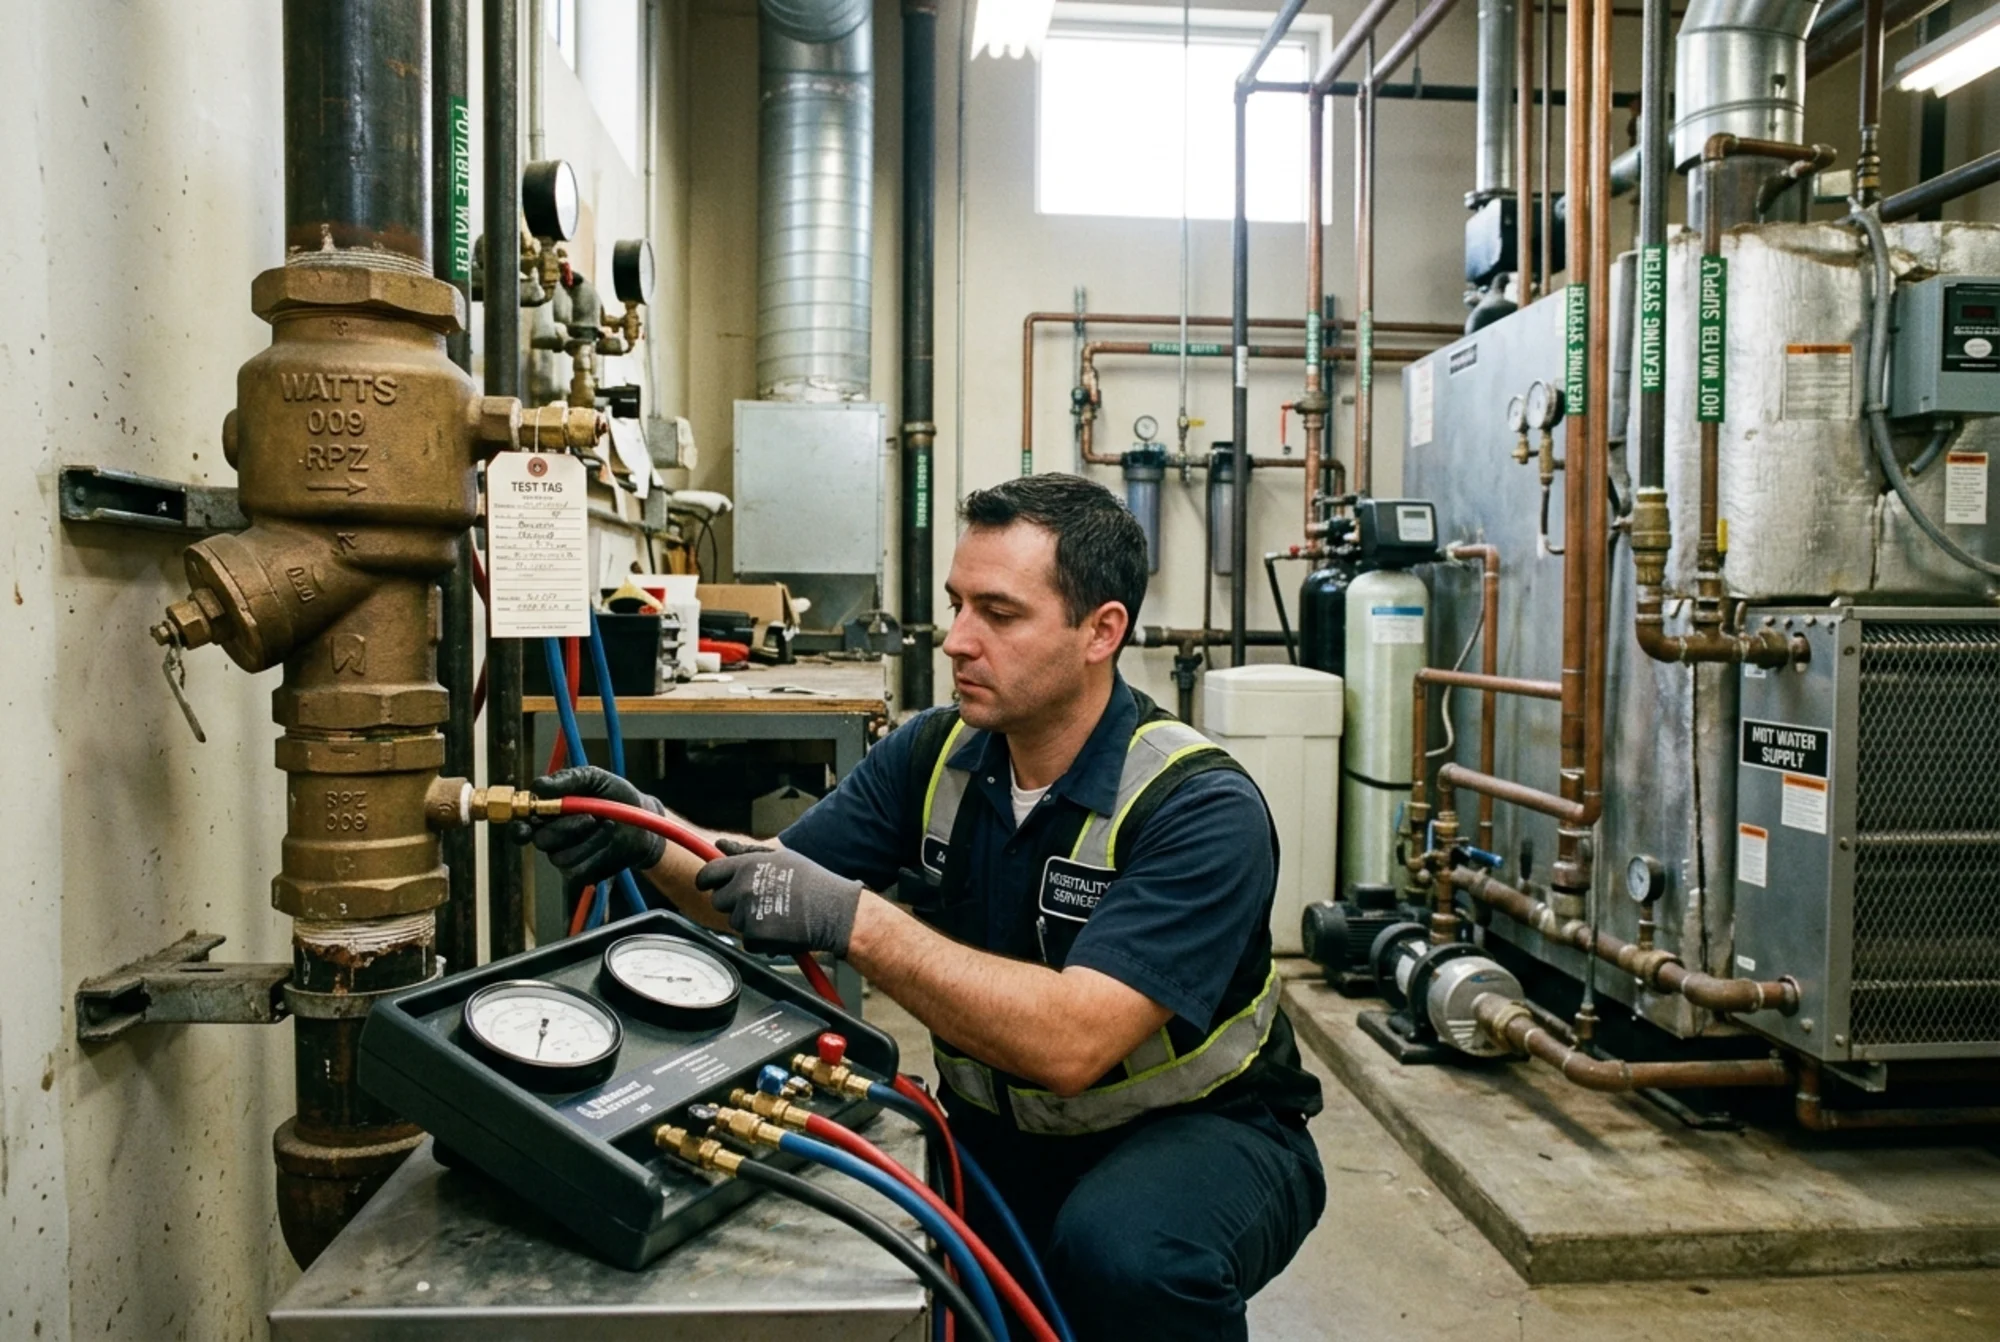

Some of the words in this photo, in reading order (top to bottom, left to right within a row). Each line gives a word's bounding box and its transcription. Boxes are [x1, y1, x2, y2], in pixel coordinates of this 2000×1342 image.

[455, 206, 470, 273] WATER
[1643, 248, 1661, 313] SYSTEM
[1702, 259, 1721, 321] SUPPLY
[280, 372, 399, 405] WATTS
[1701, 384, 1720, 416] HOT
[307, 408, 366, 436] 009
[306, 444, 370, 472] RPZ
[511, 481, 539, 493] TEST
[1776, 730, 1816, 750] WATER
[1762, 747, 1805, 768] SUPPLY
